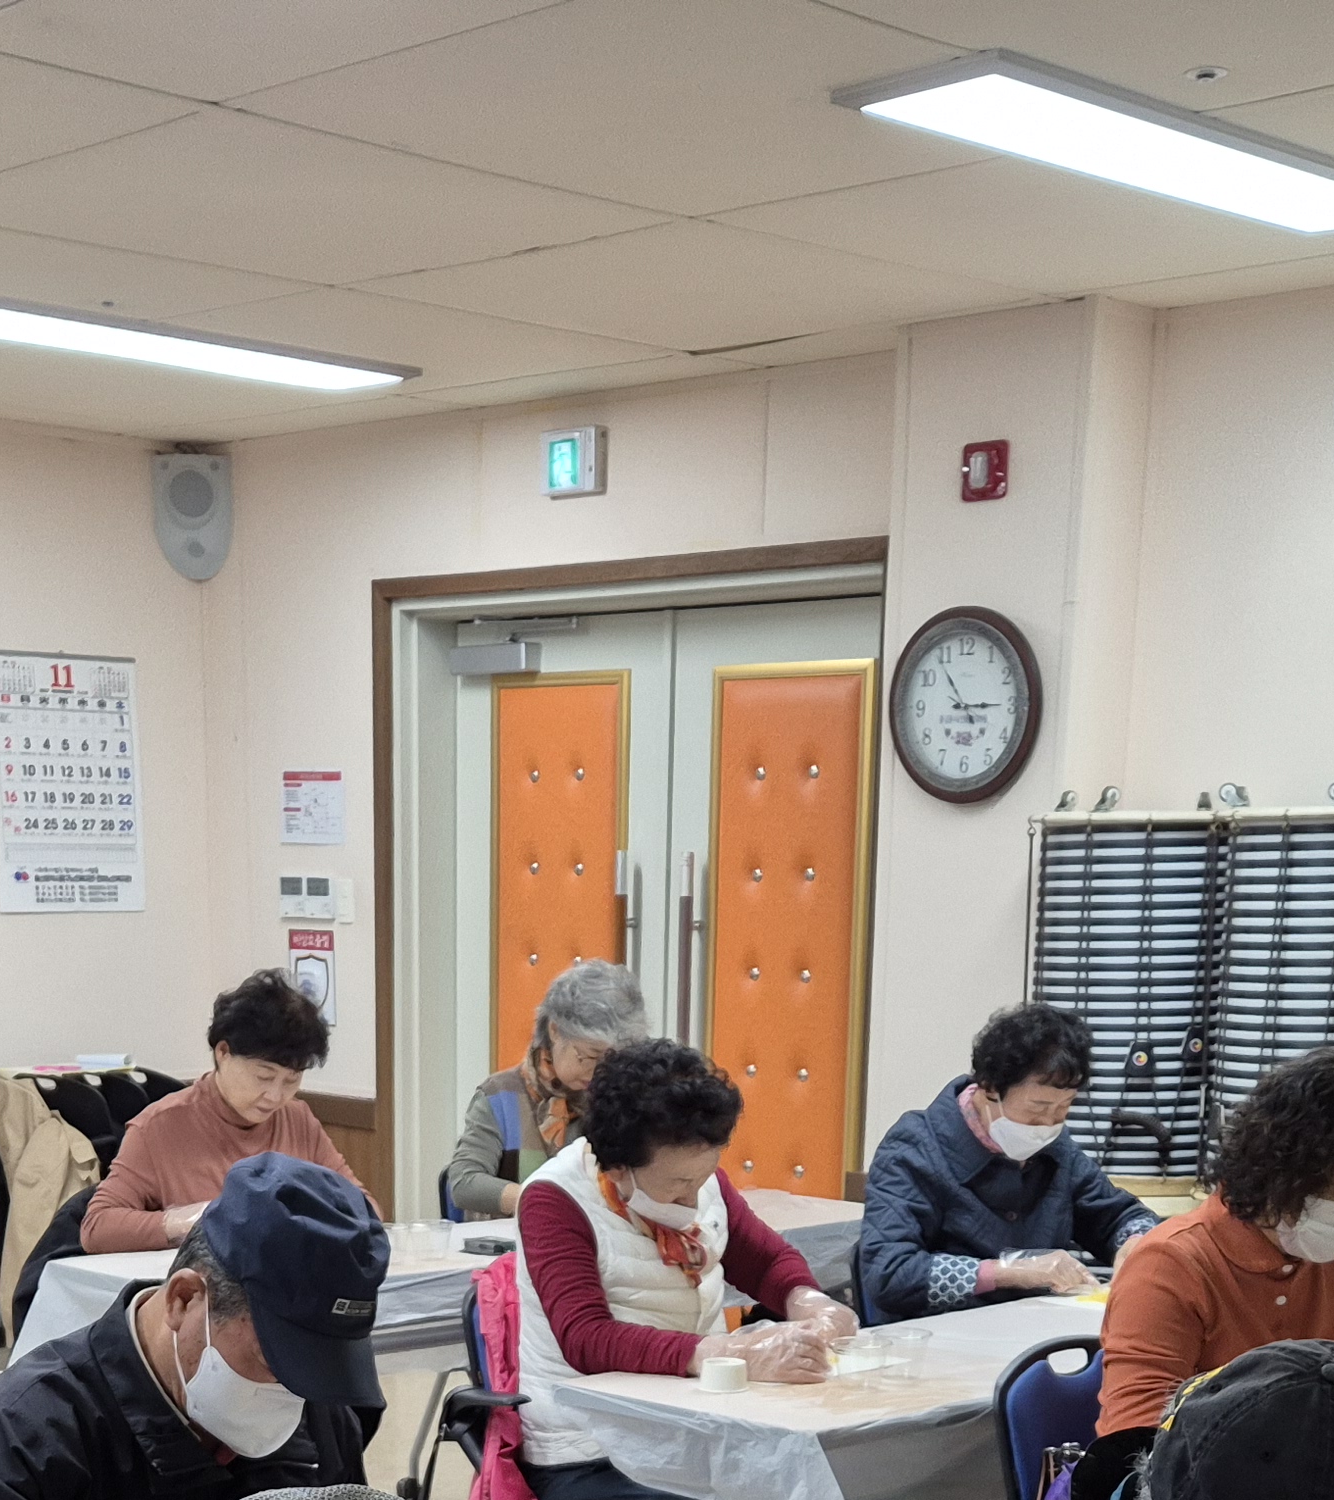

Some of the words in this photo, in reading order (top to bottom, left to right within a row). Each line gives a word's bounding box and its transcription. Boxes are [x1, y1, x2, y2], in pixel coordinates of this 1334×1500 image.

[938, 646, 952, 664] 11
[959, 637, 975, 656] 12
[987, 645, 995, 663] 1
[50, 663, 75, 688] 11
[919, 669, 937, 687] 10
[1002, 667, 1012, 685] 2
[916, 700, 926, 718] 9
[1007, 696, 1017, 714] 3
[119, 715, 125, 727] 1
[4, 736, 12, 749] 2
[24, 737, 31, 750] 3
[43, 738, 51, 750] 4
[81, 739, 89, 752] 6
[100, 740, 108, 752] 7
[922, 728, 932, 746] 8
[999, 727, 1008, 743] 4
[938, 749, 947, 766] 7
[959, 755, 969, 773] 6
[983, 748, 993, 766] 5
[5, 764, 13, 776] 9
[22, 764, 36, 776] 10
[42, 765, 54, 777] 11
[60, 765, 74, 778] 12
[79, 766, 93, 778] 13
[98, 766, 112, 779] 14
[4, 790, 18, 803] 16
[23, 791, 37, 803] 17
[43, 791, 57, 803] 18
[61, 792, 75, 804] 19
[80, 792, 95, 805] 20
[99, 793, 113, 805] 21
[117, 793, 132, 805] 22
[24, 817, 39, 830] 24
[43, 818, 59, 830] 25
[62, 818, 77, 831] 26
[81, 818, 96, 831] 27
[100, 819, 115, 831] 28
